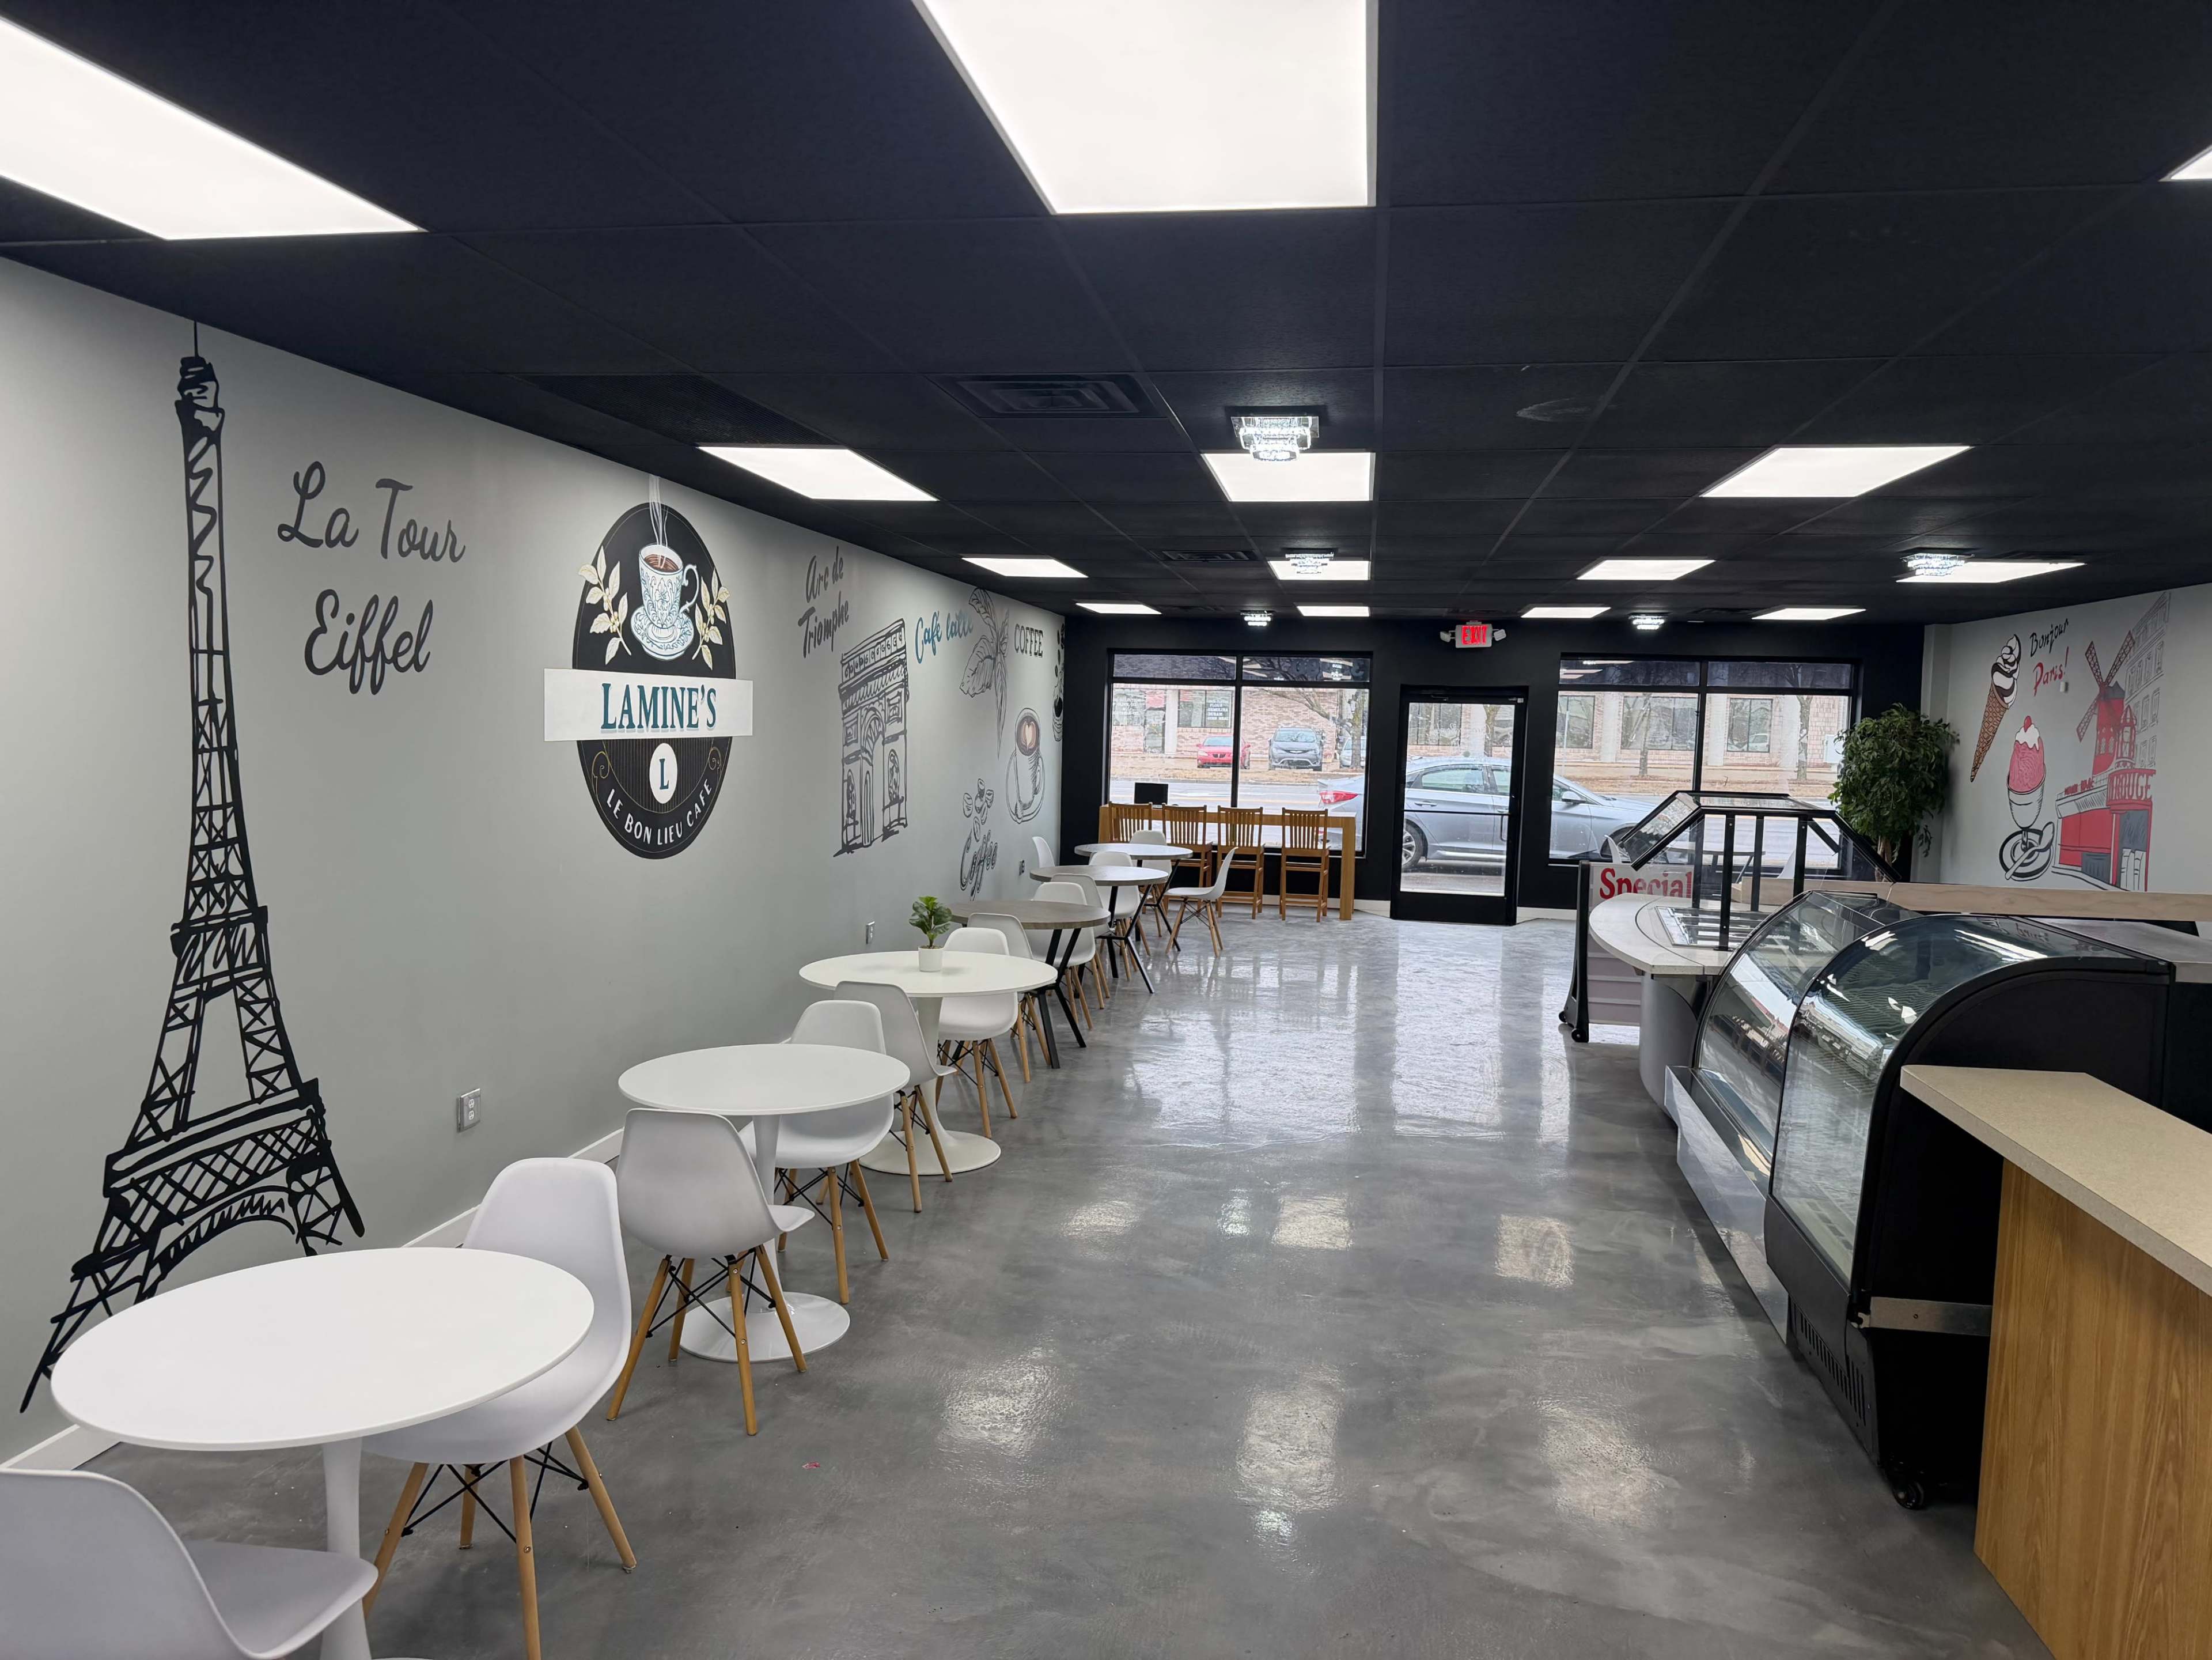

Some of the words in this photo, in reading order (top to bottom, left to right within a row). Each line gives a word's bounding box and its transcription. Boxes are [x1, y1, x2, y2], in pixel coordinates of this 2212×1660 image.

[278, 461, 359, 548] La
[375, 478, 466, 562] Tour
[832, 545, 844, 585] de
[304, 589, 433, 695] Eiffel
[798, 590, 849, 659] Triomphe
[1014, 623, 1043, 657] COFFEE
[1461, 625, 1488, 645] EXIT
[2029, 618, 2069, 657] Bonjour
[2032, 646, 2069, 697] Paris!
[601, 683, 717, 731] LAMINE'S
[659, 758, 669, 790] L
[607, 789, 623, 819] LE
[624, 813, 652, 844] BON
[657, 821, 683, 845] LIEU
[687, 779, 712, 827] CAFE
